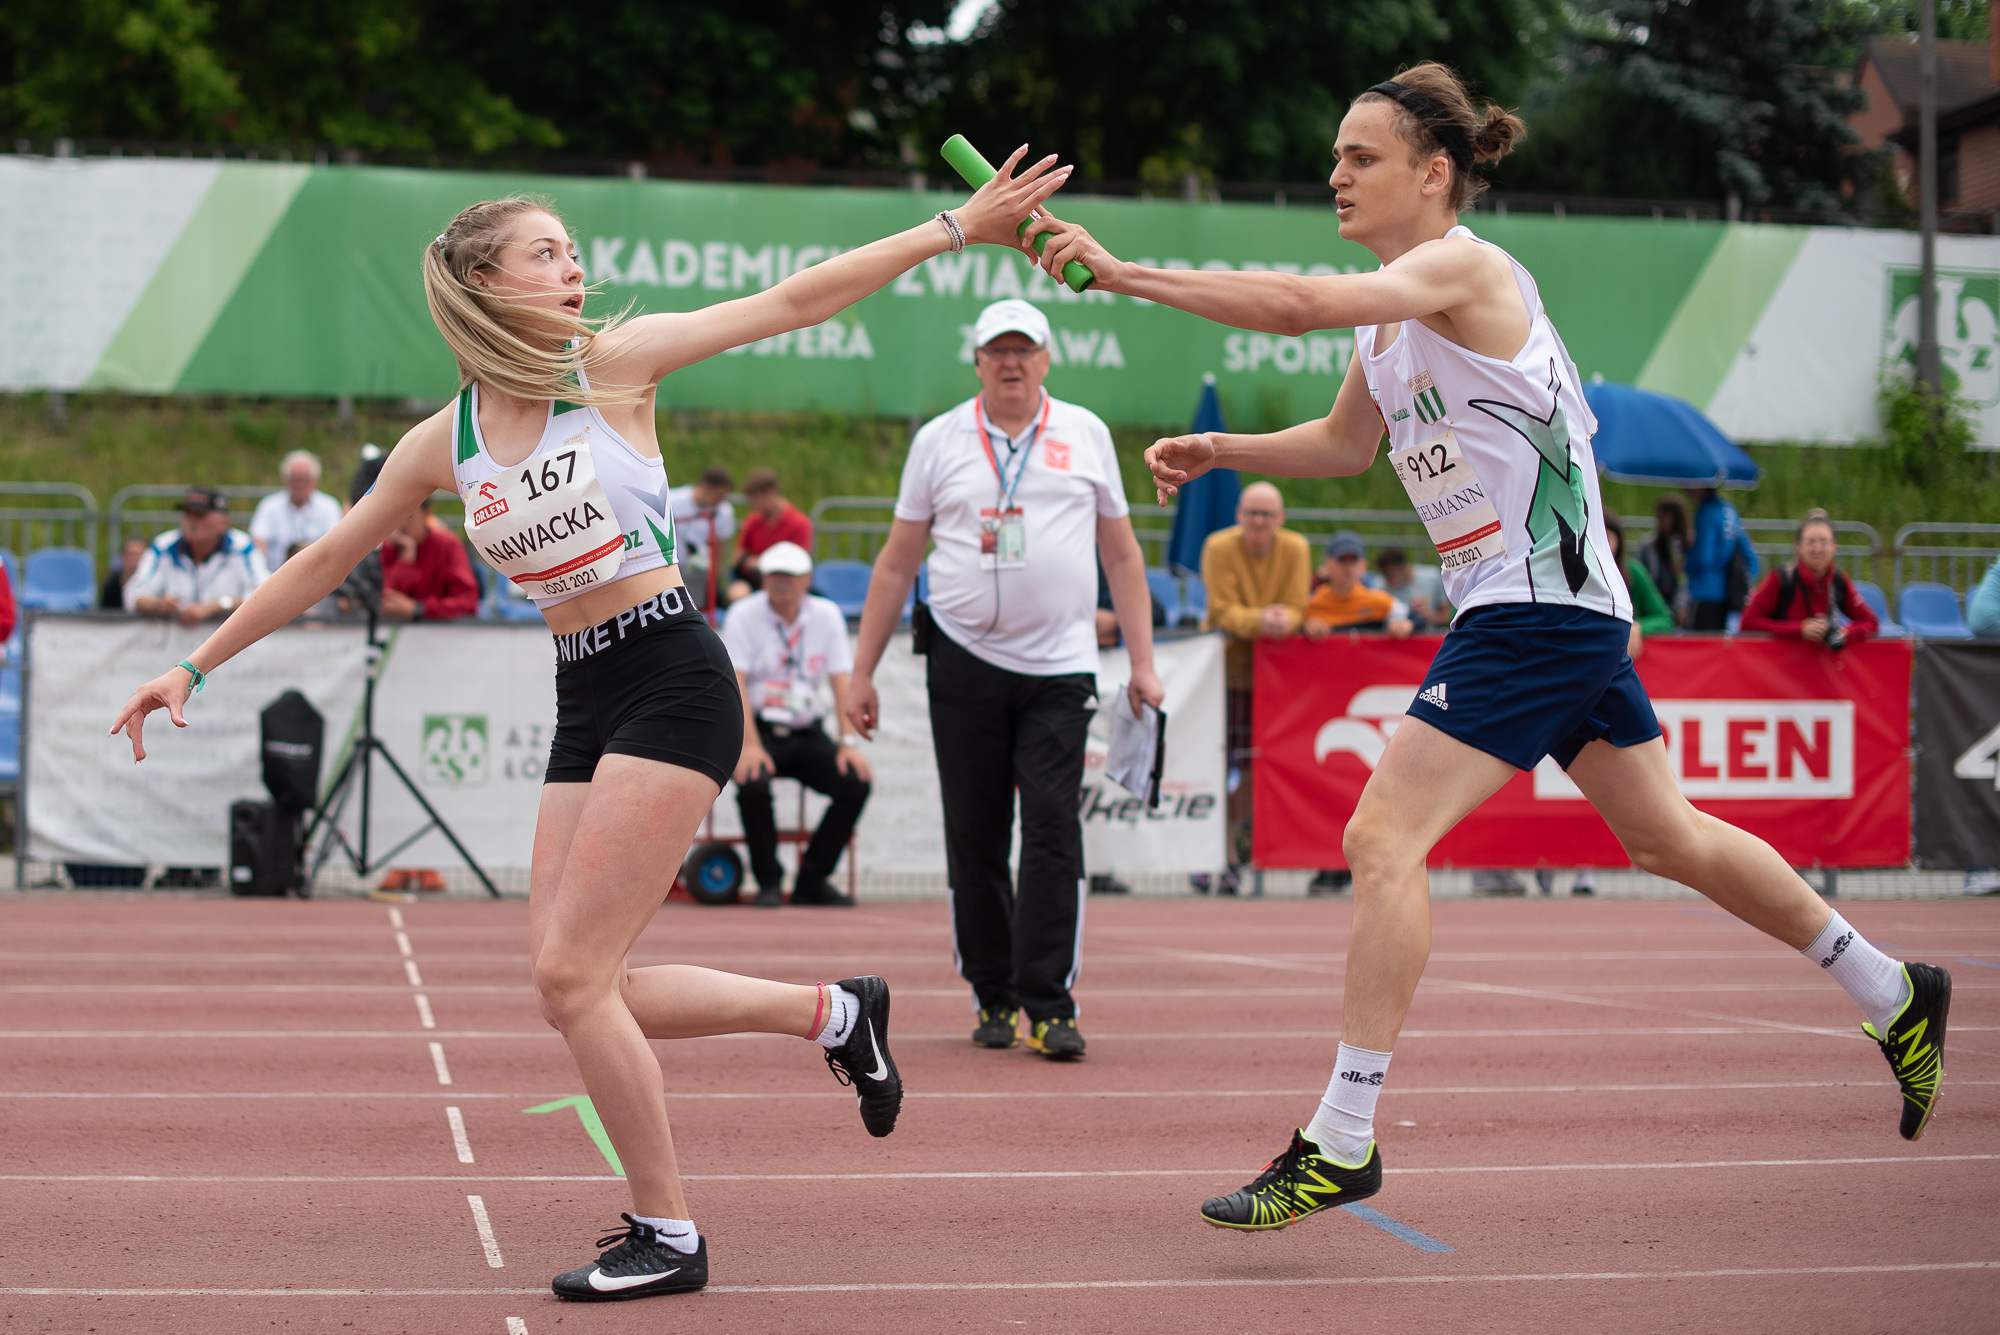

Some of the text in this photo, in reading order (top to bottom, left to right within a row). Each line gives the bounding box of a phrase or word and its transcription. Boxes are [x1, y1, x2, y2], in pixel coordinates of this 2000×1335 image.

[577, 238, 856, 291] KADEMI
[520, 450, 577, 501] 167
[1407, 444, 1456, 483] 912
[475, 500, 507, 524] ORLEN
[484, 502, 605, 564] NAWACKA
[1458, 546, 1482, 564] 2021
[569, 568, 599, 588] 2021
[558, 588, 684, 662] NIKE PRO
[1419, 692, 1449, 710] adidas
[505, 724, 556, 748] AZ
[1660, 718, 1832, 780] LEN
